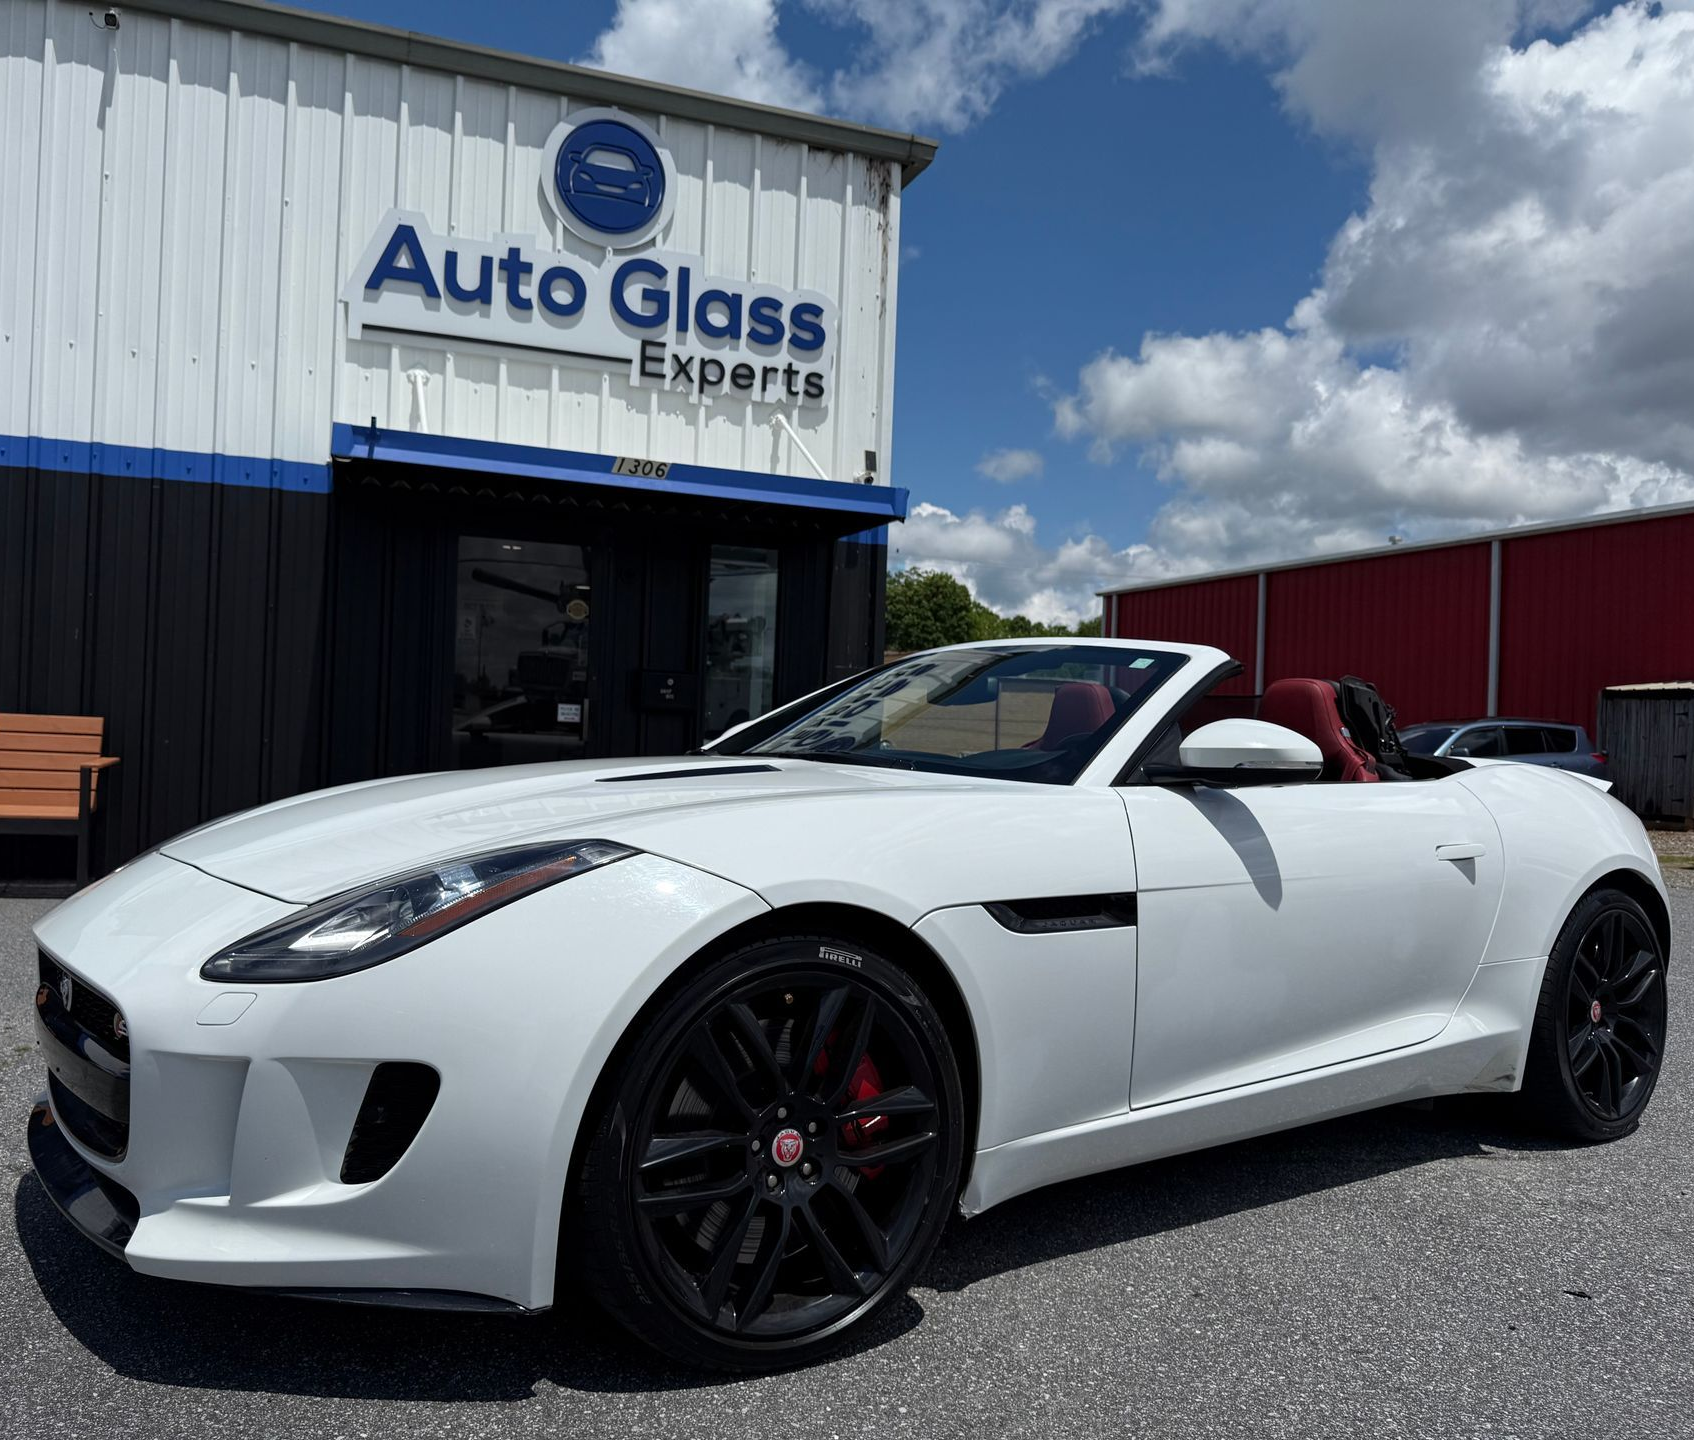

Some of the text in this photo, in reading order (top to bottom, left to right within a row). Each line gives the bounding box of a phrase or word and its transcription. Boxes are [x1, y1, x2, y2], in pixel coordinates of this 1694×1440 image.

[365, 224, 826, 351] Auto Glass
[640, 340, 824, 399] Experts
[617, 457, 668, 478] 1306
[1041, 918, 1098, 928] JAGUAR
[819, 946, 862, 968] PIRELLI
